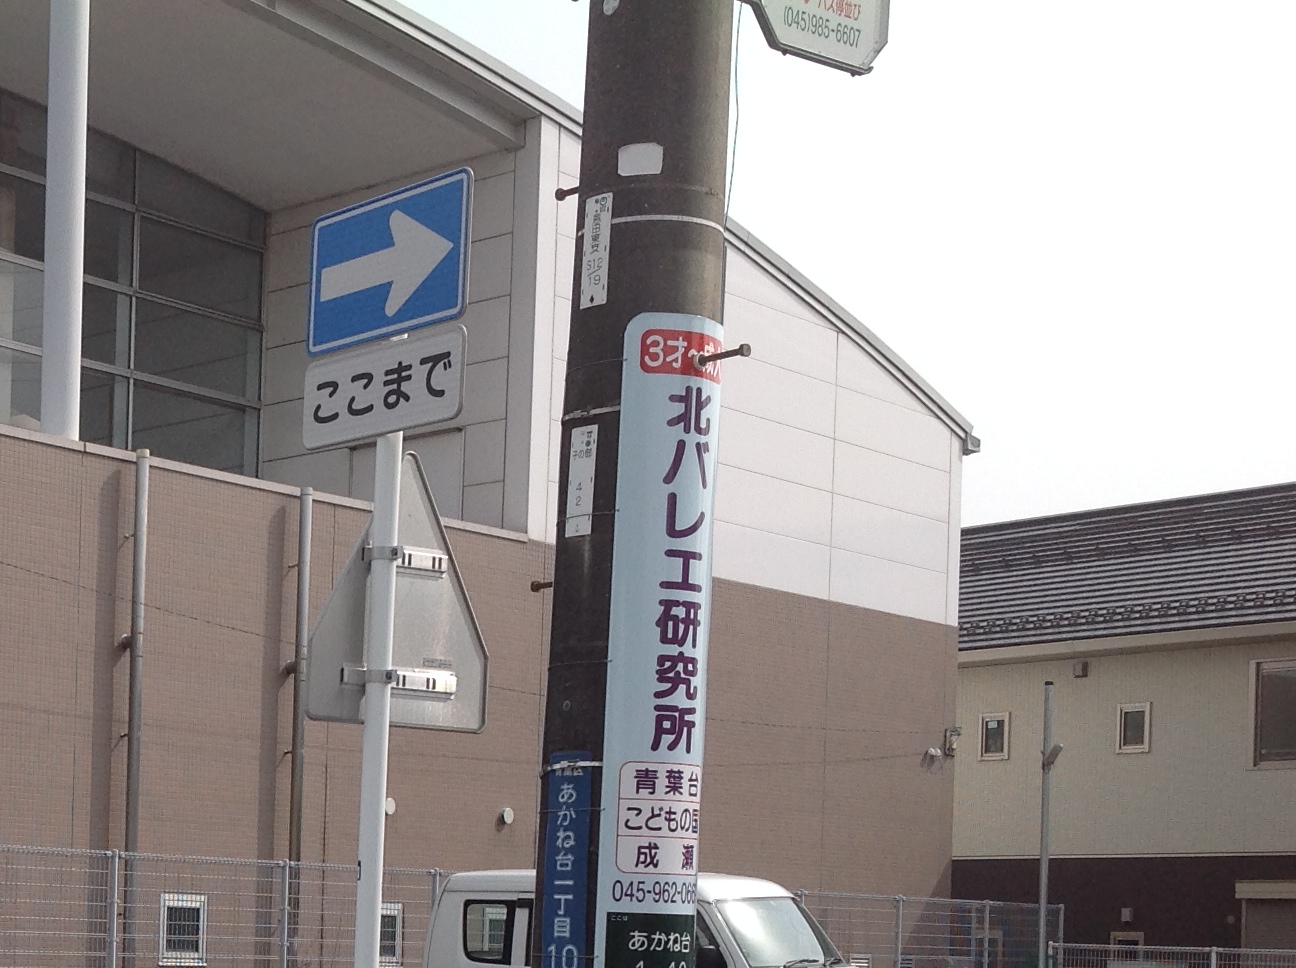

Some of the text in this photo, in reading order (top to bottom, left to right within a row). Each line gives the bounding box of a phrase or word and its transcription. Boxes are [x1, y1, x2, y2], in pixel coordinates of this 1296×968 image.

[784, 6, 862, 49] (045)985-6607
[313, 351, 452, 424] ここまで
[649, 385, 711, 755] 北バレエ研究所
[633, 767, 699, 797] 青葉台
[628, 930, 691, 953] あかね台
